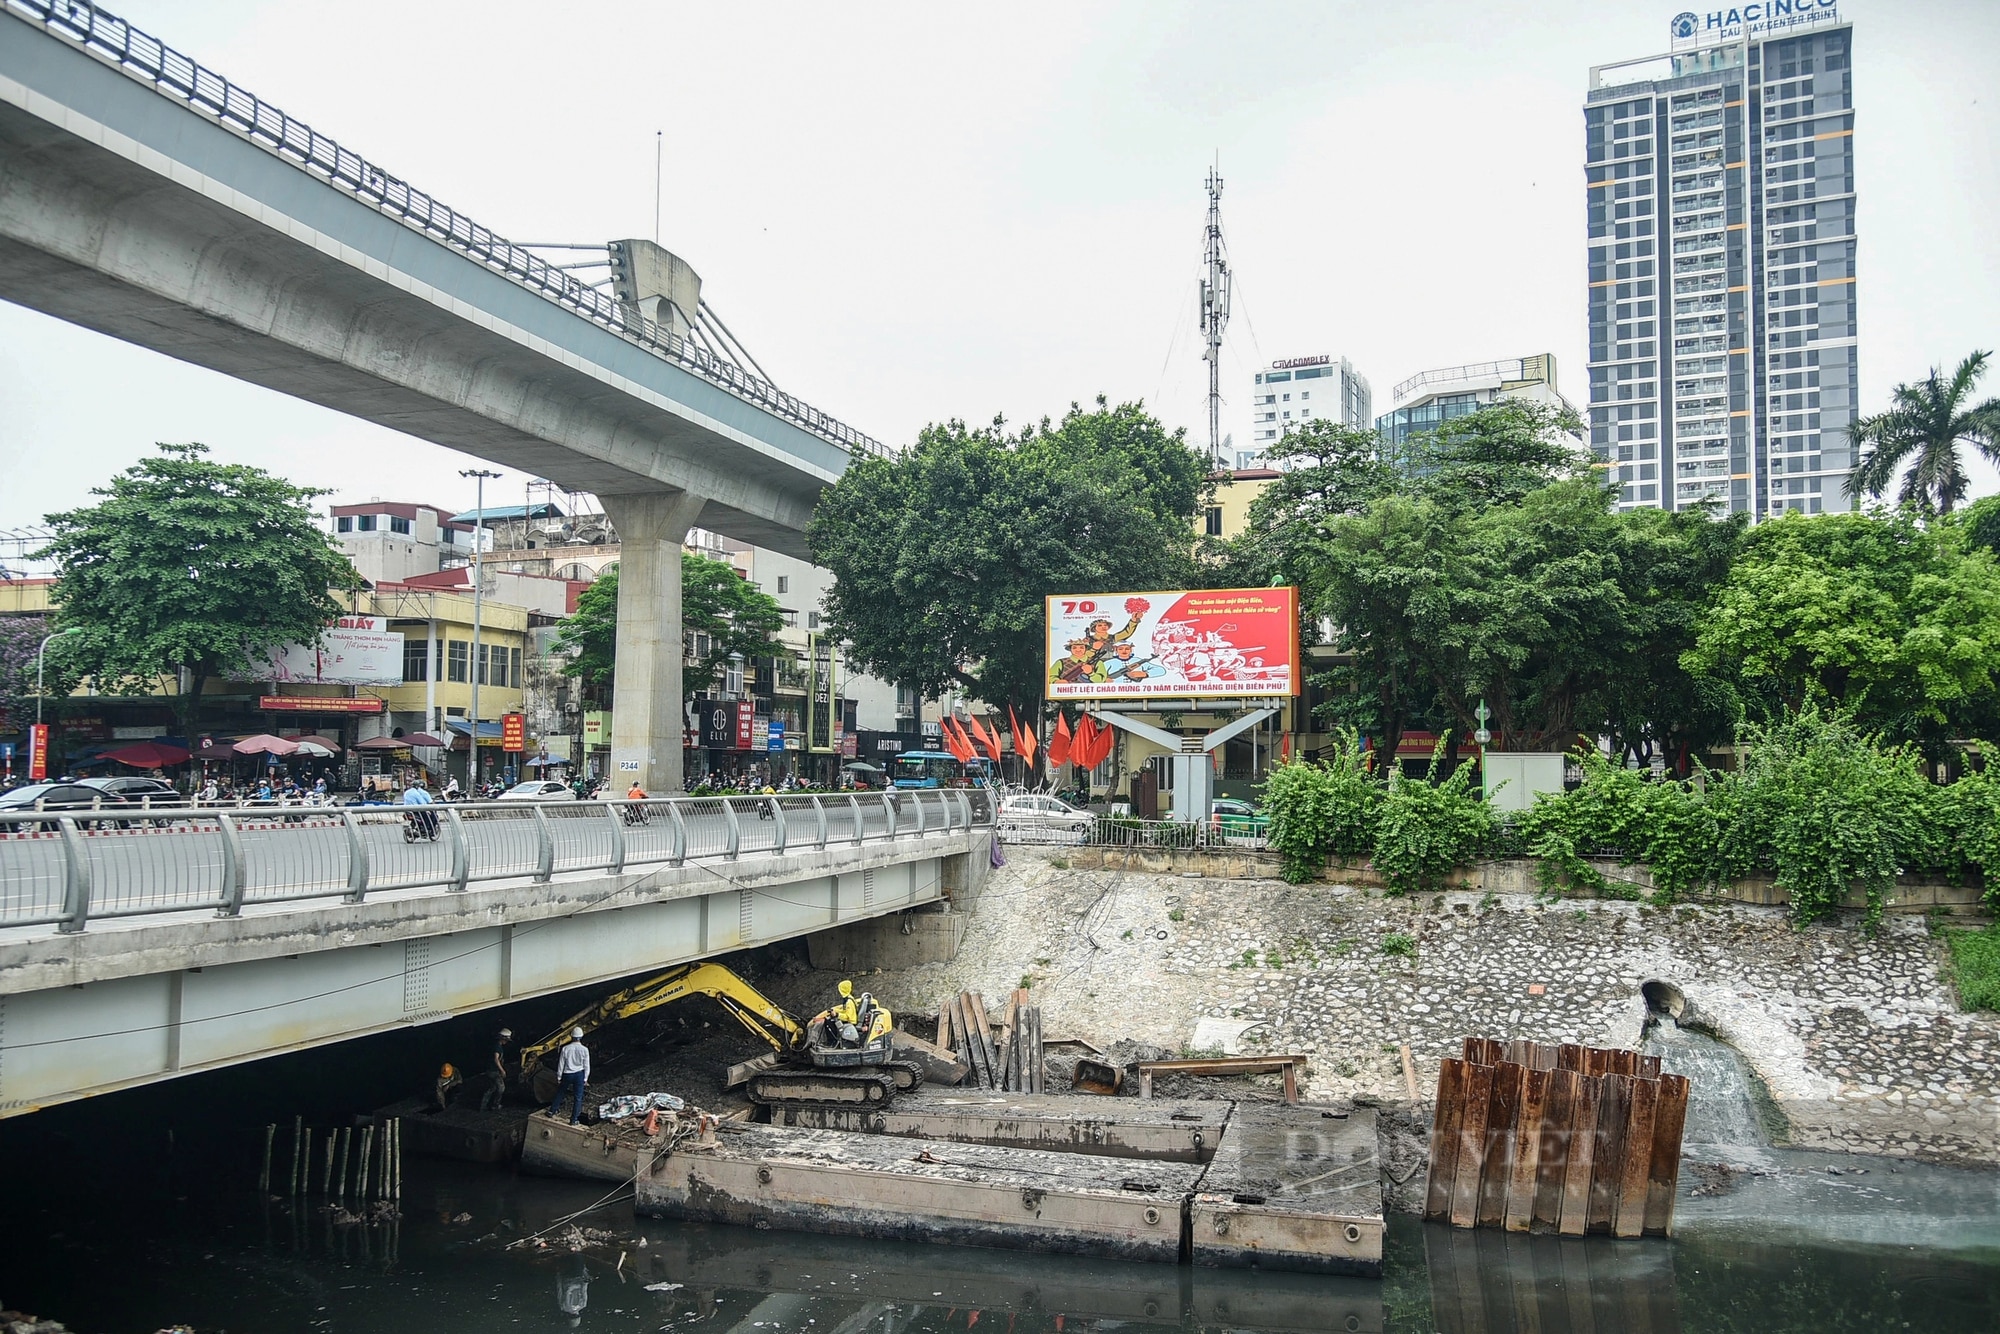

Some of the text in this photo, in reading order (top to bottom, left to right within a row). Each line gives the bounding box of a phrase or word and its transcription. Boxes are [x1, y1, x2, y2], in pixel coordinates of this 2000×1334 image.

[1767, 14, 1804, 31] CENTER
[1806, 9, 1837, 23] POINT
[1293, 354, 1330, 367] COMPLEX
[1061, 601, 1097, 614] 70
[339, 617, 375, 630] GIẤY
[1057, 686, 1078, 695] NHIỆT
[1079, 685, 1095, 695] LIỆT
[1142, 685, 1152, 693] 70
[1225, 682, 1244, 692] ĐIỆN
[710, 731, 728, 741] ELLY
[877, 739, 902, 751] ARISTINO
[620, 762, 638, 770] P344
[653, 985, 684, 1002] YANMAR
